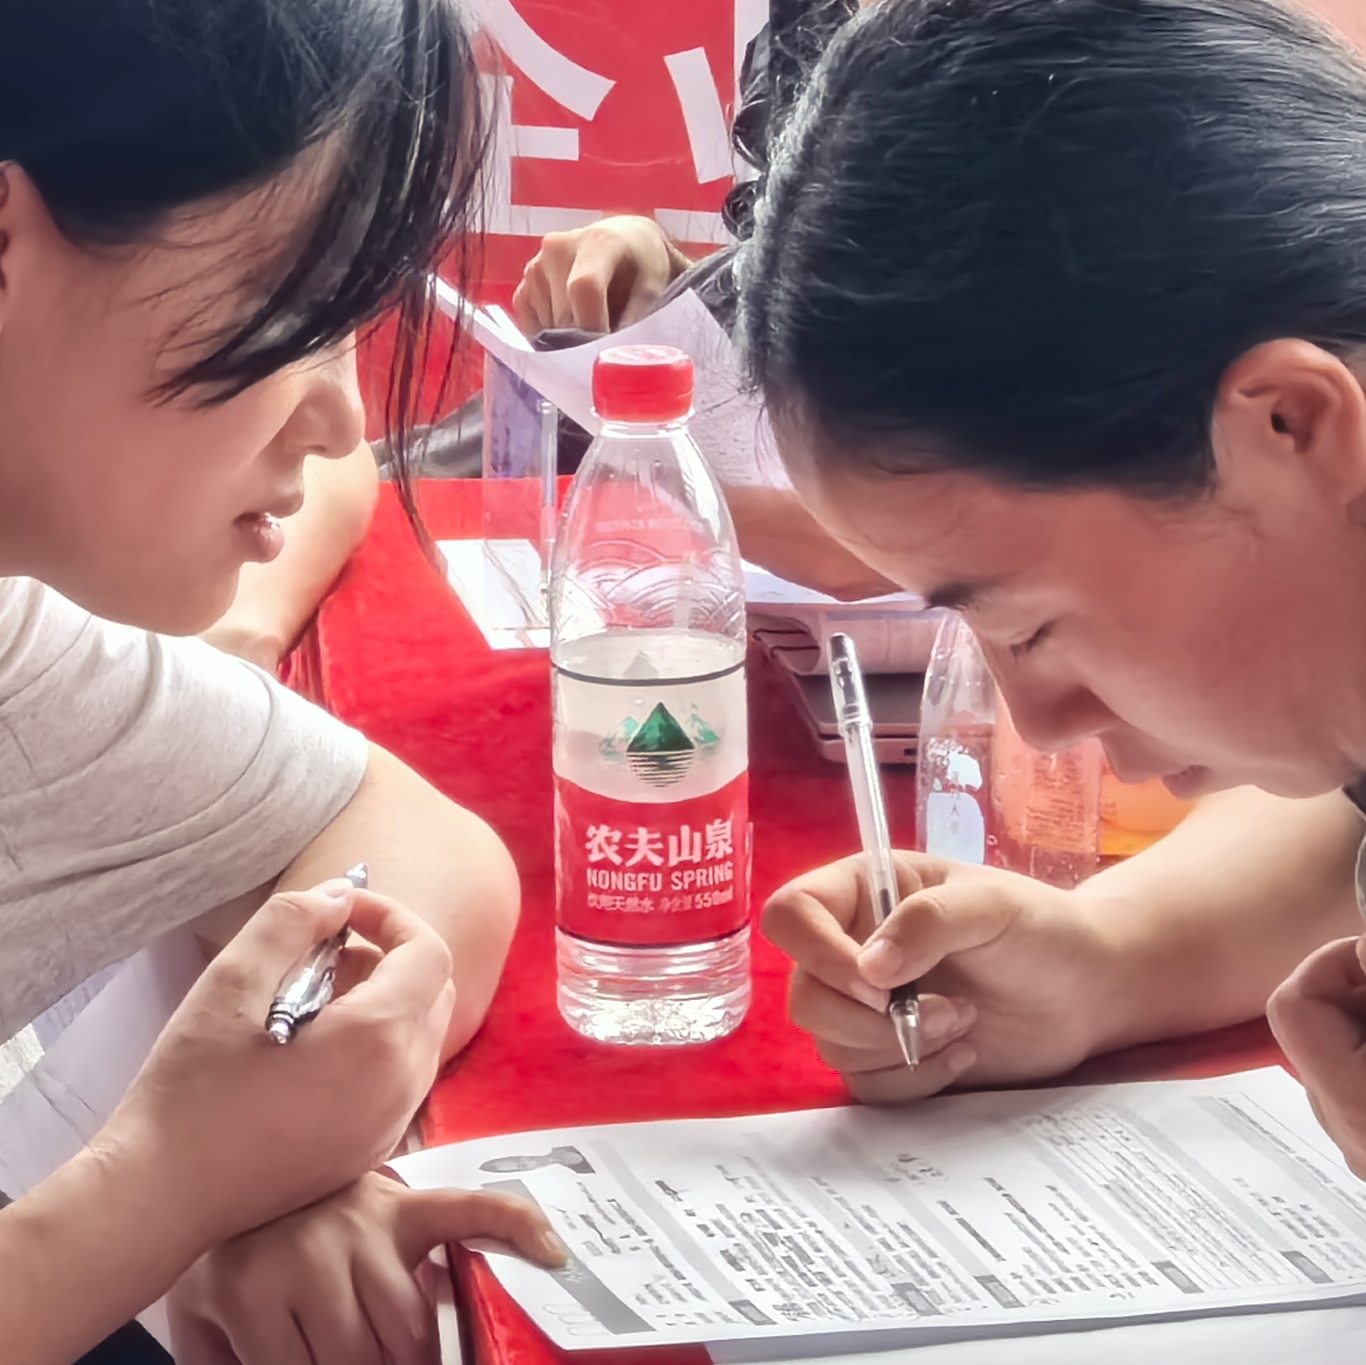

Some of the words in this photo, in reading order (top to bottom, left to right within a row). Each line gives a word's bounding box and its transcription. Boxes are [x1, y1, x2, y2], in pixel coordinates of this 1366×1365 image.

[585, 818, 733, 868] 农夫山泉
[587, 868, 663, 892] NONGFU
[670, 861, 733, 890] SPRING
